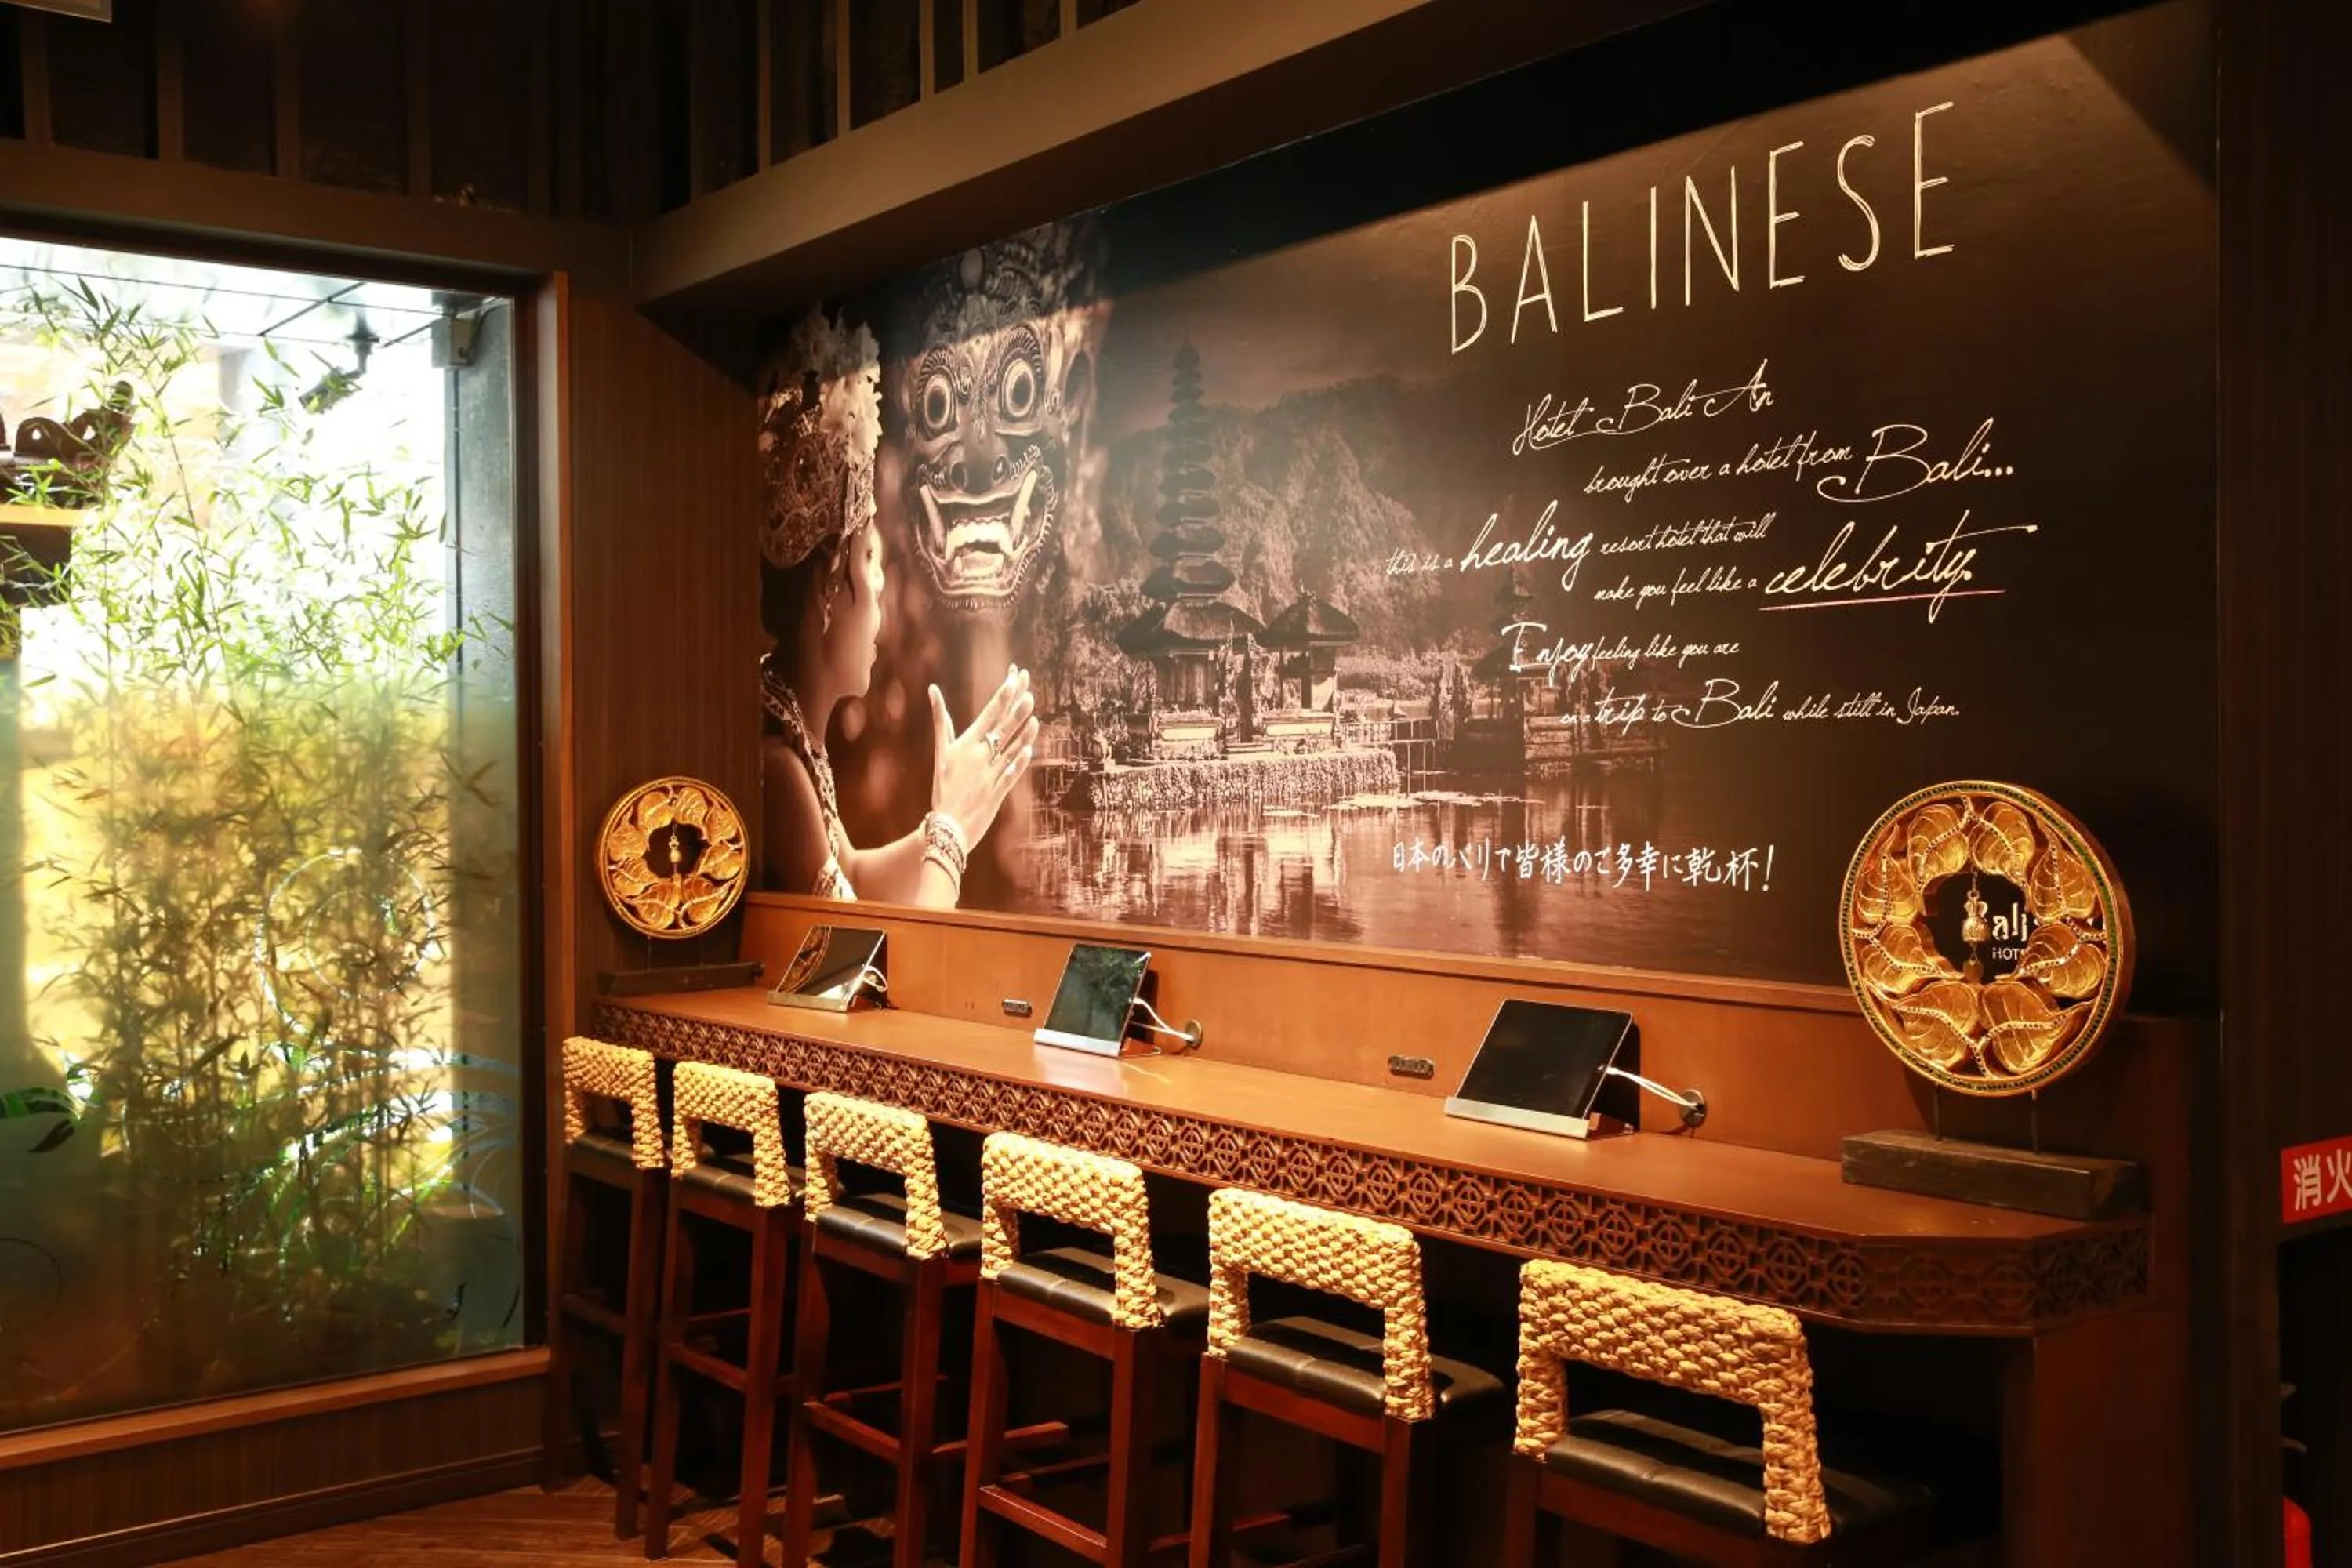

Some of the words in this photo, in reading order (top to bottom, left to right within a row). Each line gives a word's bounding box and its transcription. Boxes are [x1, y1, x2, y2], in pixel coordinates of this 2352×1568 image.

[1450, 101, 1955, 354] BALINESE
[1512, 394, 1595, 456] Hotel
[1595, 379, 1698, 435] Bali
[1692, 358, 1775, 412] An
[1584, 453, 1689, 503] brought
[1662, 463, 1712, 484] over
[1719, 463, 1730, 475] a
[1736, 434, 1803, 475] hotel
[1794, 430, 1854, 481] from
[1817, 417, 2013, 502] Bali...
[1386, 548, 1417, 575] this
[1421, 554, 1440, 572] is
[1443, 557, 1454, 568] a
[1459, 499, 1594, 592] healing
[1600, 524, 1661, 554] resort
[1655, 520, 1697, 549] hotel
[1696, 515, 1739, 544] that
[1733, 512, 1777, 542] will
[1594, 575, 1635, 601] make
[1638, 583, 1668, 611] you
[1670, 568, 1711, 607] feel
[1704, 566, 1743, 592] like
[1748, 578, 1758, 589] a
[1764, 509, 2038, 624] celebrity.
[1501, 622, 1595, 688] Enjoy
[1591, 636, 1641, 671] feeling
[1644, 633, 1677, 657] like
[1681, 644, 1709, 669] you
[1713, 641, 1740, 654] are
[1559, 713, 1578, 724] on
[1581, 712, 1591, 723] a
[1594, 686, 1647, 736] trip
[1651, 699, 1682, 724] to
[1671, 677, 1779, 728] Bali
[1782, 693, 1830, 720] while
[1833, 691, 1882, 719] still
[1875, 701, 1896, 717] in
[1896, 686, 1961, 726] Japan.
[2293, 1148, 2352, 1211] 消火
